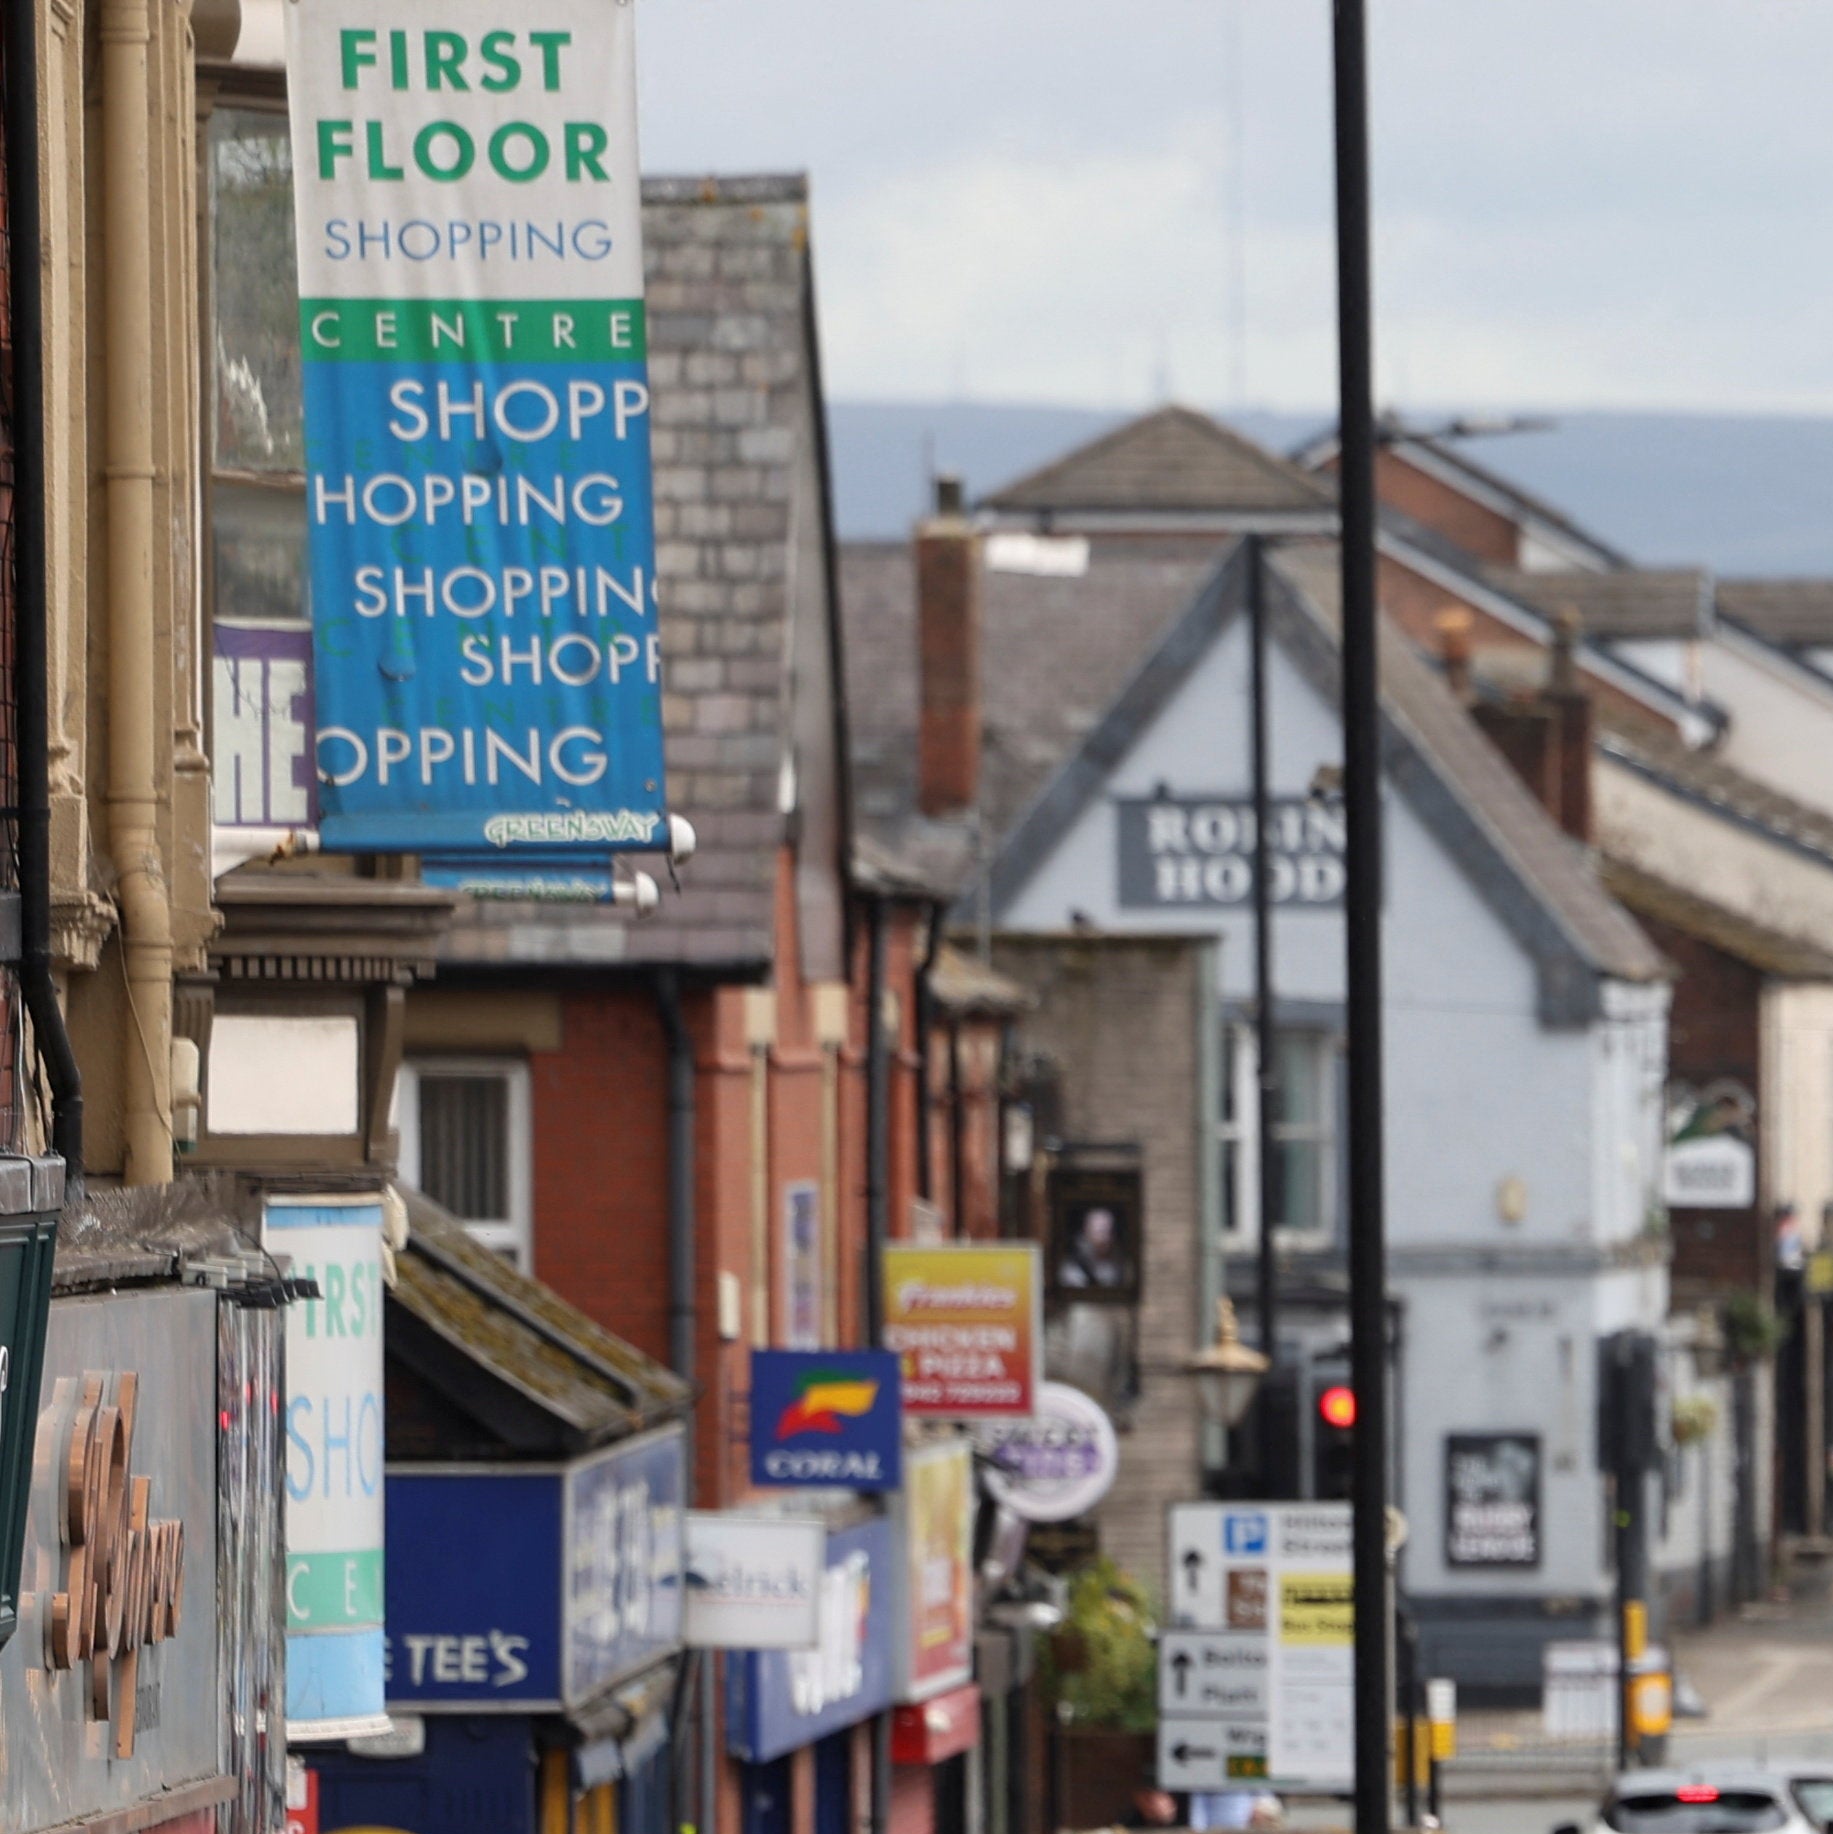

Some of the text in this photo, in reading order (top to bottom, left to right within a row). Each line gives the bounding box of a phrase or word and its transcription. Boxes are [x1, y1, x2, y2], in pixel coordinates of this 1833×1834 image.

[340, 29, 572, 92] FIRST
[316, 120, 611, 184] FLOOR
[323, 219, 614, 262] SHOPPING
[311, 312, 633, 349] CENTRE
[390, 379, 649, 442] SHOPP
[315, 473, 624, 527] HOPPING
[315, 726, 608, 787] OPPING
[1155, 854, 1347, 902] HOOD
[764, 1450, 882, 1480] CORAL
[404, 1629, 530, 1687] TEE'S
